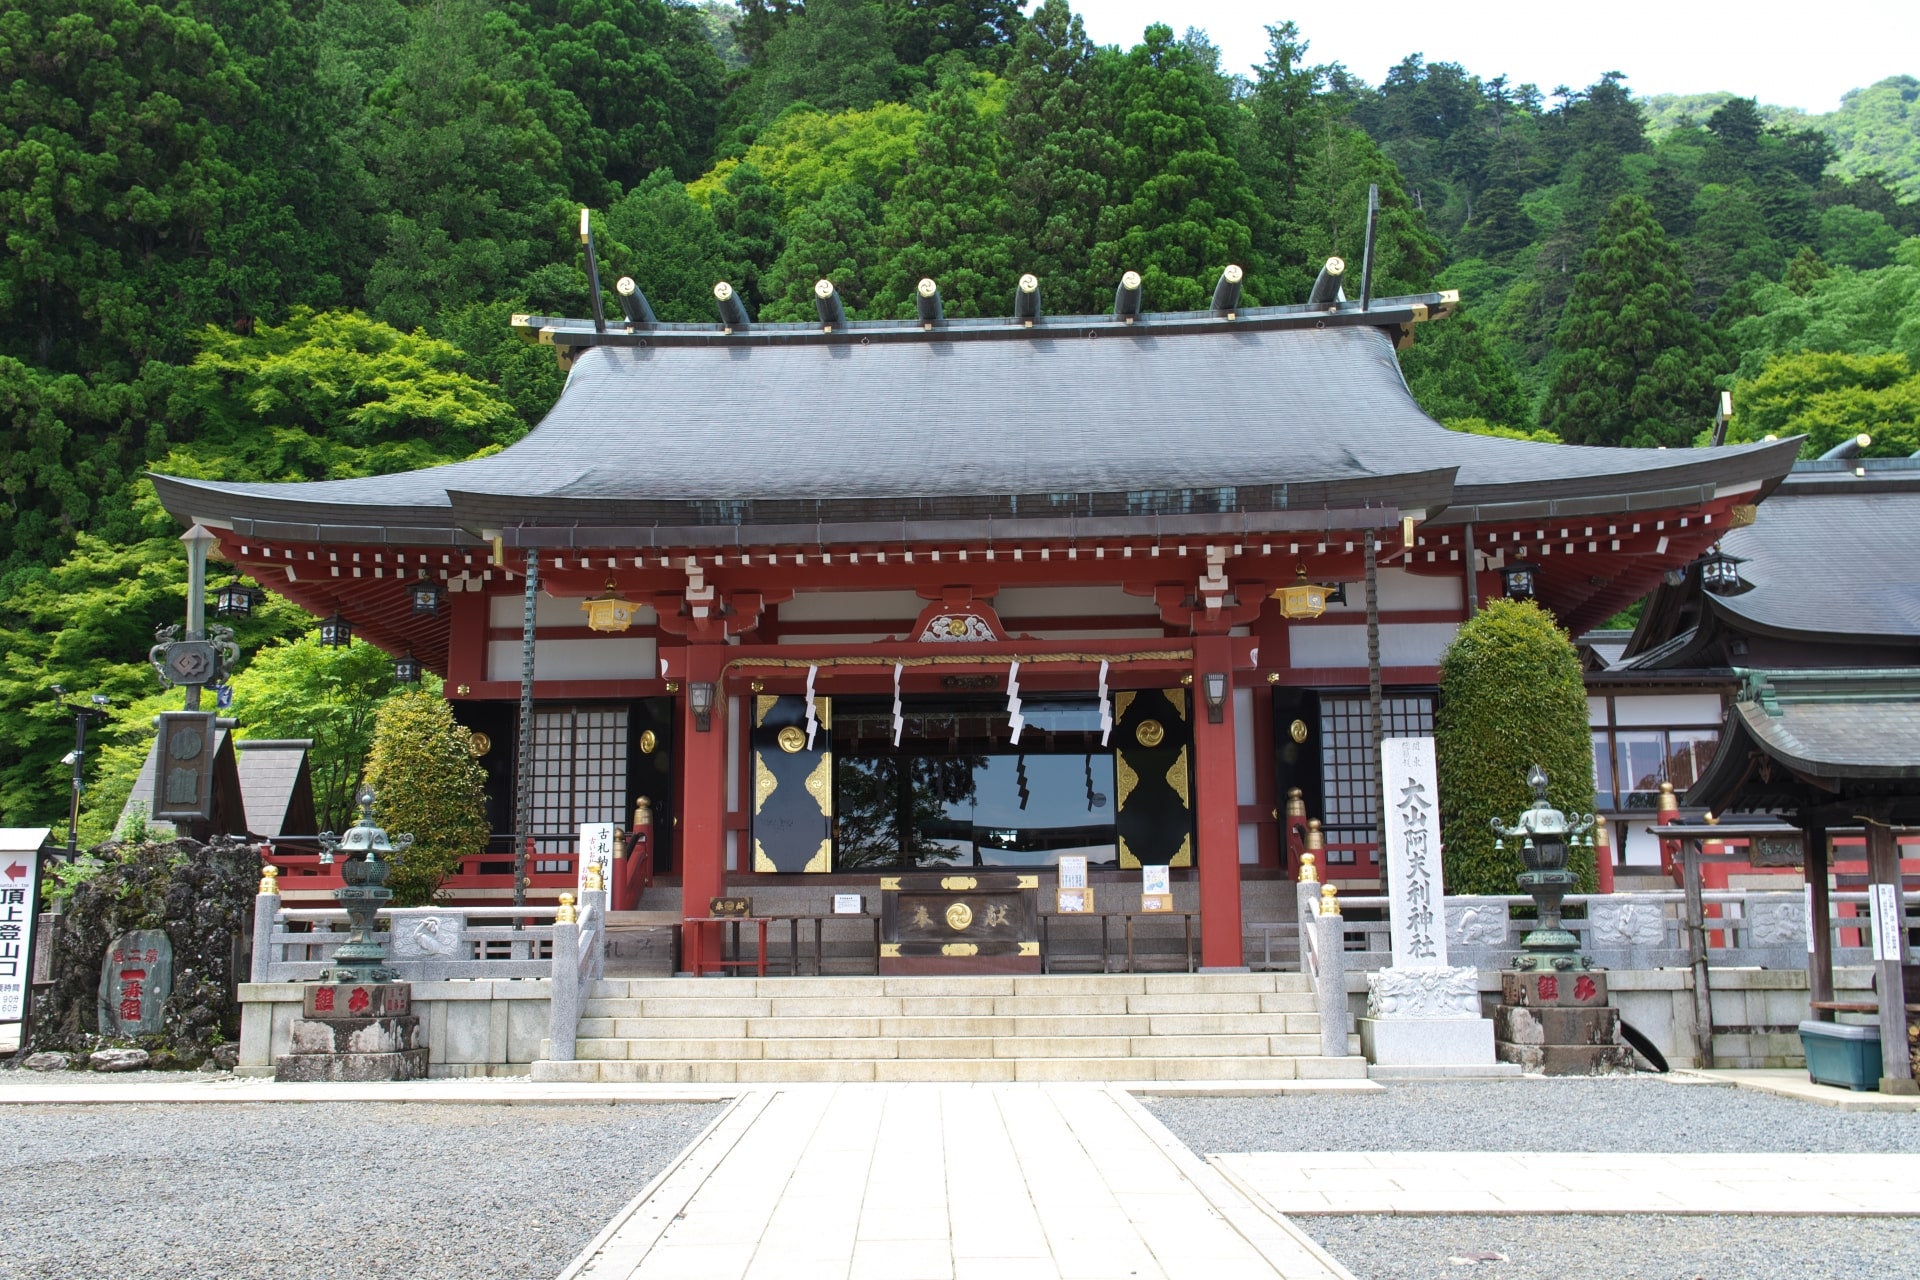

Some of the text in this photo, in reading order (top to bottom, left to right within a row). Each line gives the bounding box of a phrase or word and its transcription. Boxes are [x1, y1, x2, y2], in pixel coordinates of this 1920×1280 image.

[1396, 777, 1437, 959] 大山阿夫利神社
[0, 888, 26, 976] 頂上登山口
[120, 969, 147, 1020] 一番組
